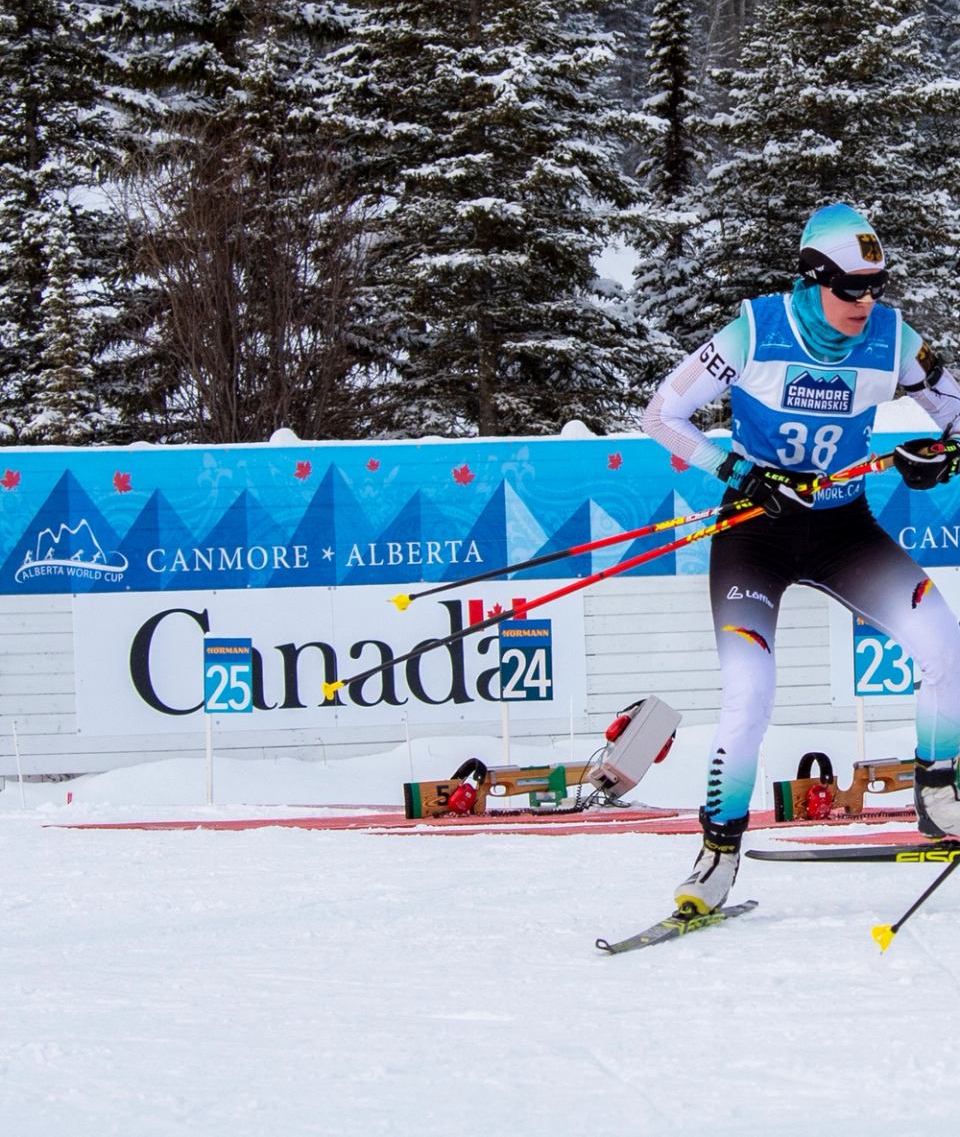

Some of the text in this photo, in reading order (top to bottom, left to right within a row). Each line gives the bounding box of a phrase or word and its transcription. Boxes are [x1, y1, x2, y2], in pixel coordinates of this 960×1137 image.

[699, 342, 737, 385] GER
[786, 396, 849, 411] KANANASKIS
[788, 385, 850, 401] CANMORE
[776, 421, 844, 470] 38
[764, 471, 790, 484] LEKI
[146, 539, 484, 573] CANMORE ALBERTA
[22, 565, 124, 583] ALBERTA WORLD CUP
[502, 648, 551, 698] 24
[855, 637, 914, 693] 23
[206, 665, 250, 711] 25
[436, 785, 450, 806] 5
